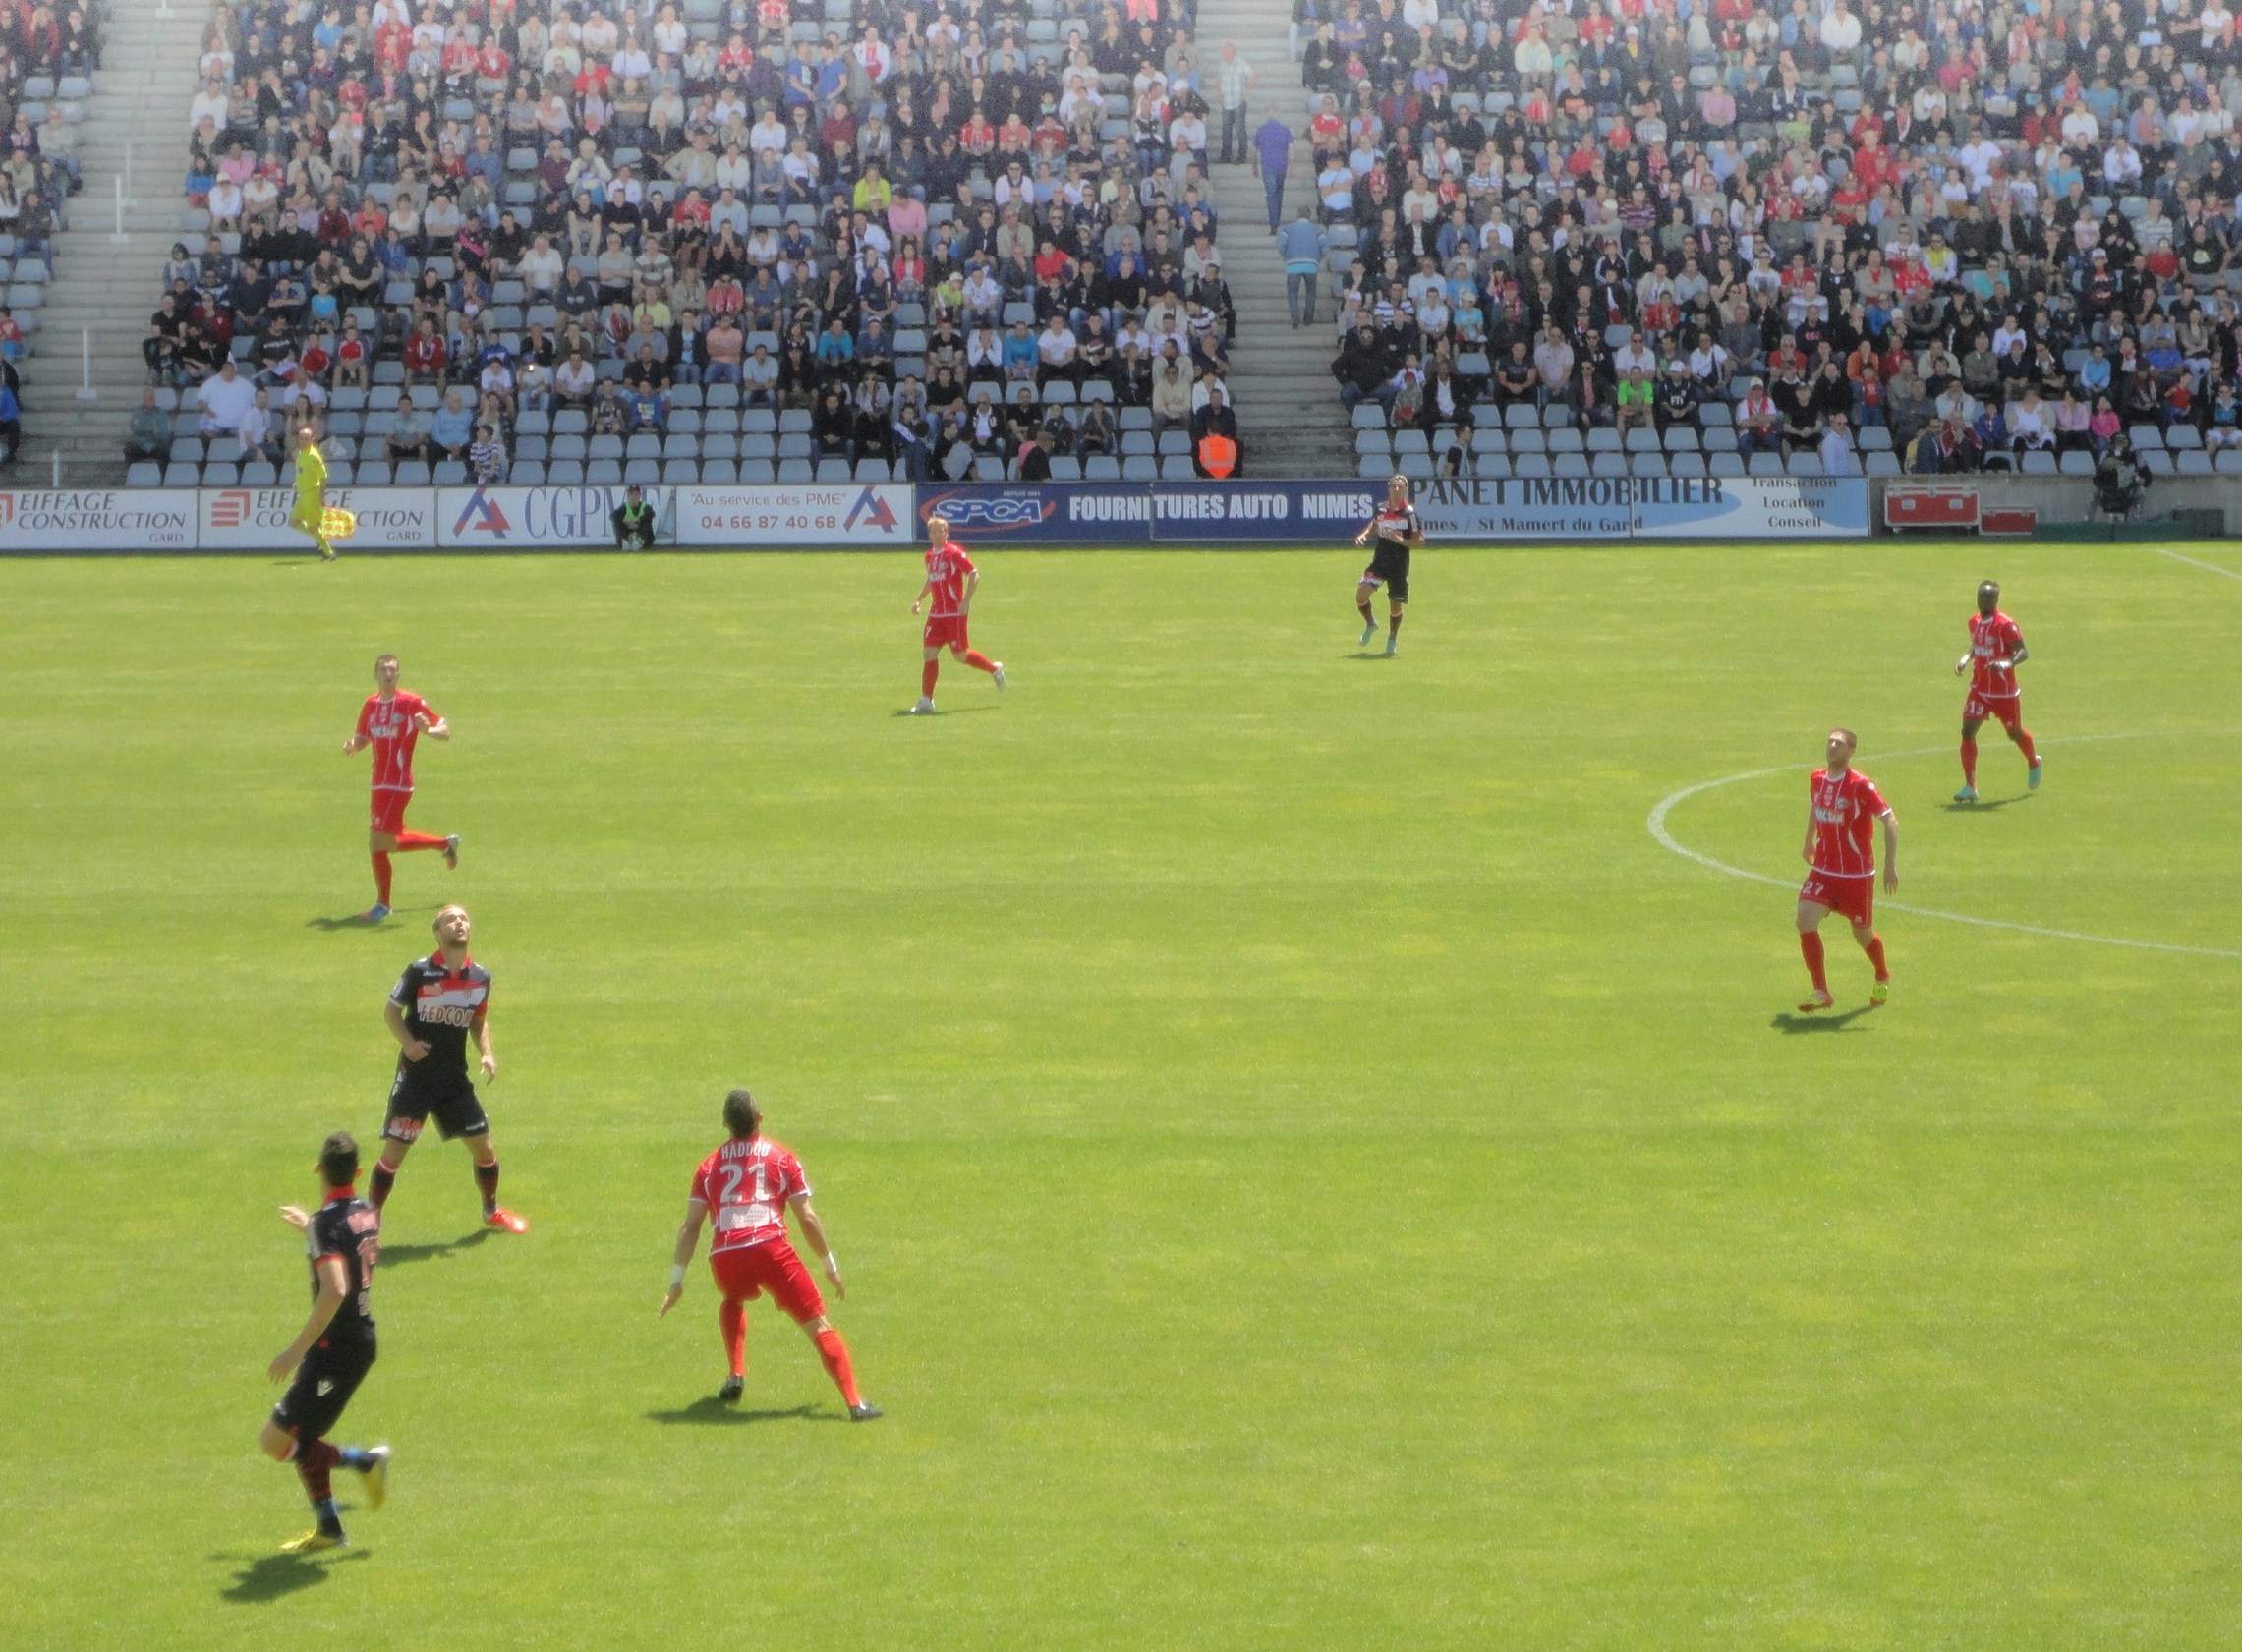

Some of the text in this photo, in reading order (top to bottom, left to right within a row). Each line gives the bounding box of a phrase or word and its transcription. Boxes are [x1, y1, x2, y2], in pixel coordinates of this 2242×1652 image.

[719, 493, 771, 506] service
[776, 493, 800, 506] des
[1523, 478, 1724, 506] IMMOBILIER
[19, 492, 116, 511] EIFFAGE
[1229, 494, 1288, 519] AUTO
[1302, 494, 1373, 519] NIMES
[1763, 495, 1825, 509] Location
[18, 512, 187, 530] CONSTRUCTION
[701, 516, 835, 529] 04 66 87 40 68
[1478, 517, 1495, 532] St
[1502, 517, 1565, 532] Mamert
[1572, 516, 1593, 532] du
[1599, 516, 1642, 532] Gard
[1767, 515, 1821, 528] Conseil
[148, 532, 184, 542] GARD
[386, 530, 421, 541] GARD
[721, 1142, 772, 1160] HADDOU
[719, 1163, 771, 1204] 21
